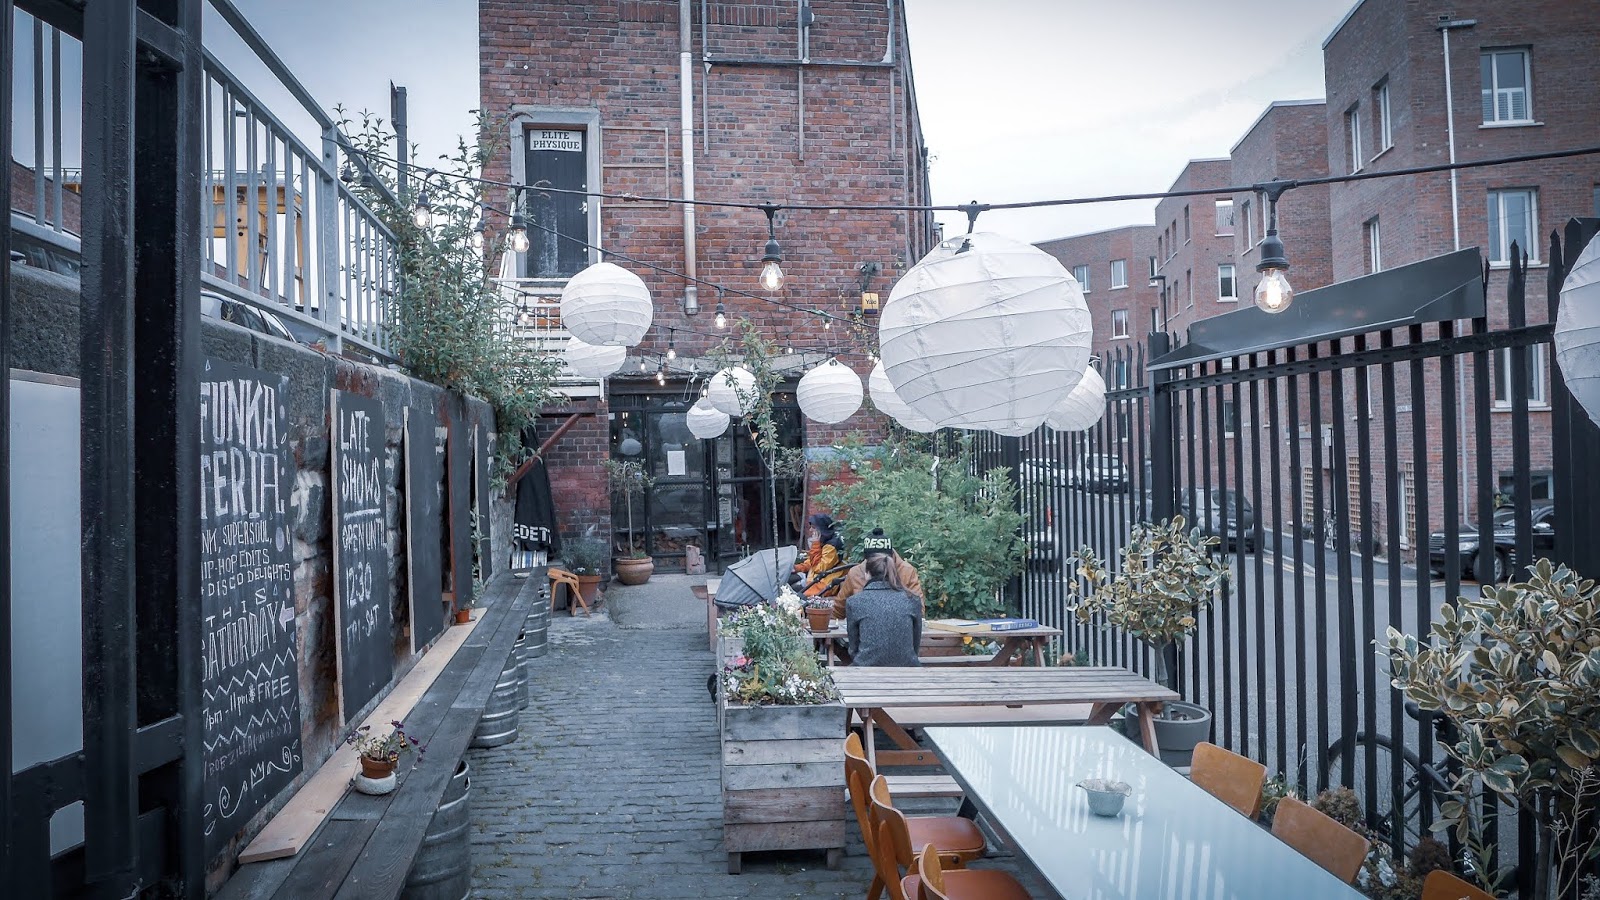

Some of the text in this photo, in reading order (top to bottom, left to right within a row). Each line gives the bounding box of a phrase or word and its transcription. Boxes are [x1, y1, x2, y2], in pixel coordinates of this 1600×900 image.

[533, 140, 580, 150] PHYSIQUE
[541, 131, 570, 140] ELITE
[340, 407, 371, 453] LATE
[342, 453, 381, 506] SHOWS
[222, 519, 273, 546] SUPERSOUL,
[342, 516, 388, 554] OPEN UNTIL
[239, 548, 270, 568] EDITS
[208, 572, 245, 597] DISCO
[246, 562, 291, 582] DELIGHTS
[345, 561, 373, 610] 12:30
[205, 588, 267, 629] THIS
[257, 675, 292, 702] FREE
